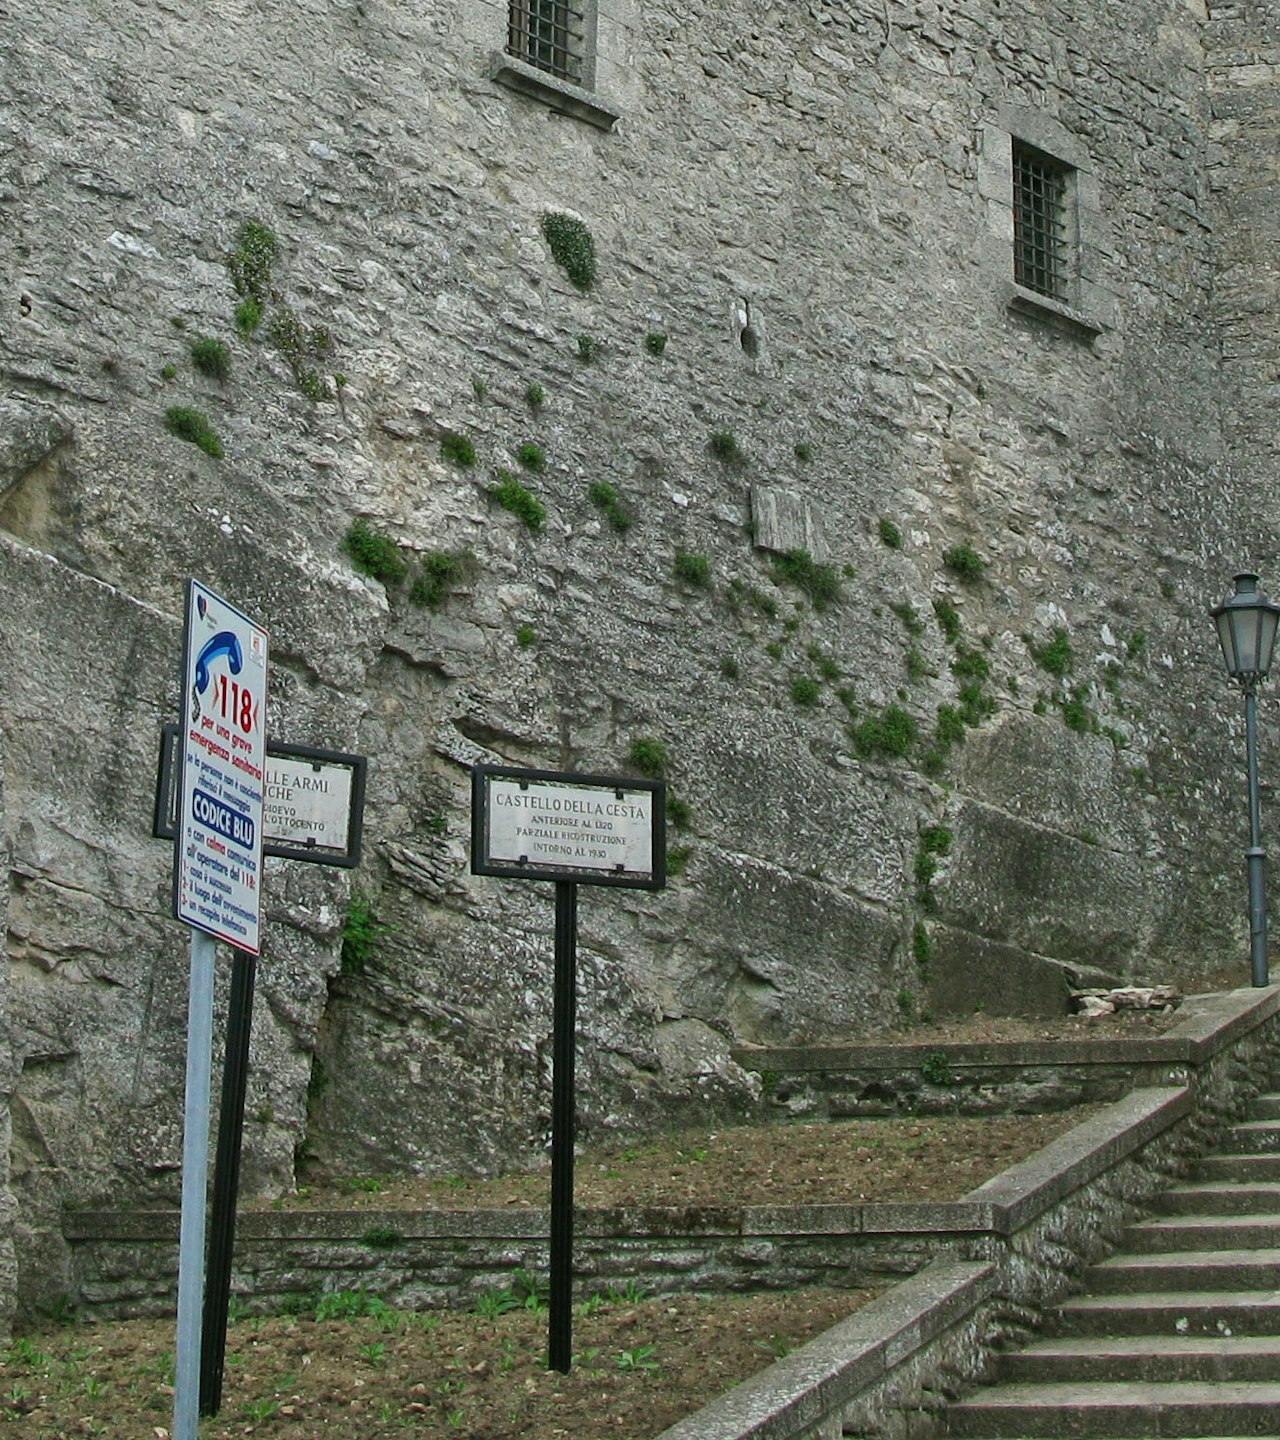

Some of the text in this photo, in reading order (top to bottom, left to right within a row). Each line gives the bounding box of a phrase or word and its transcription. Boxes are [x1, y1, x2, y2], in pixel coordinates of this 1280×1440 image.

[221, 674, 252, 733] 118
[201, 715, 252, 754] per una grave
[190, 729, 262, 781] emergenza sanitaria
[194, 753, 200, 767] la
[201, 761, 223, 780] persona
[224, 775, 234, 787] non
[292, 776, 329, 793] ARMI
[194, 794, 252, 845] CODICE BLU
[496, 793, 646, 820] CASTELLO DELLA CESTA
[531, 814, 579, 827] ANTERIORE
[581, 820, 593, 829] AL
[193, 830, 204, 844] con
[206, 835, 226, 856] calma
[227, 848, 257, 872] comunica
[516, 826, 627, 846] PARZIALE RICOSTRUZIONE
[533, 842, 572, 855] INTORNO
[574, 846, 586, 857] AL
[230, 864, 240, 881] del
